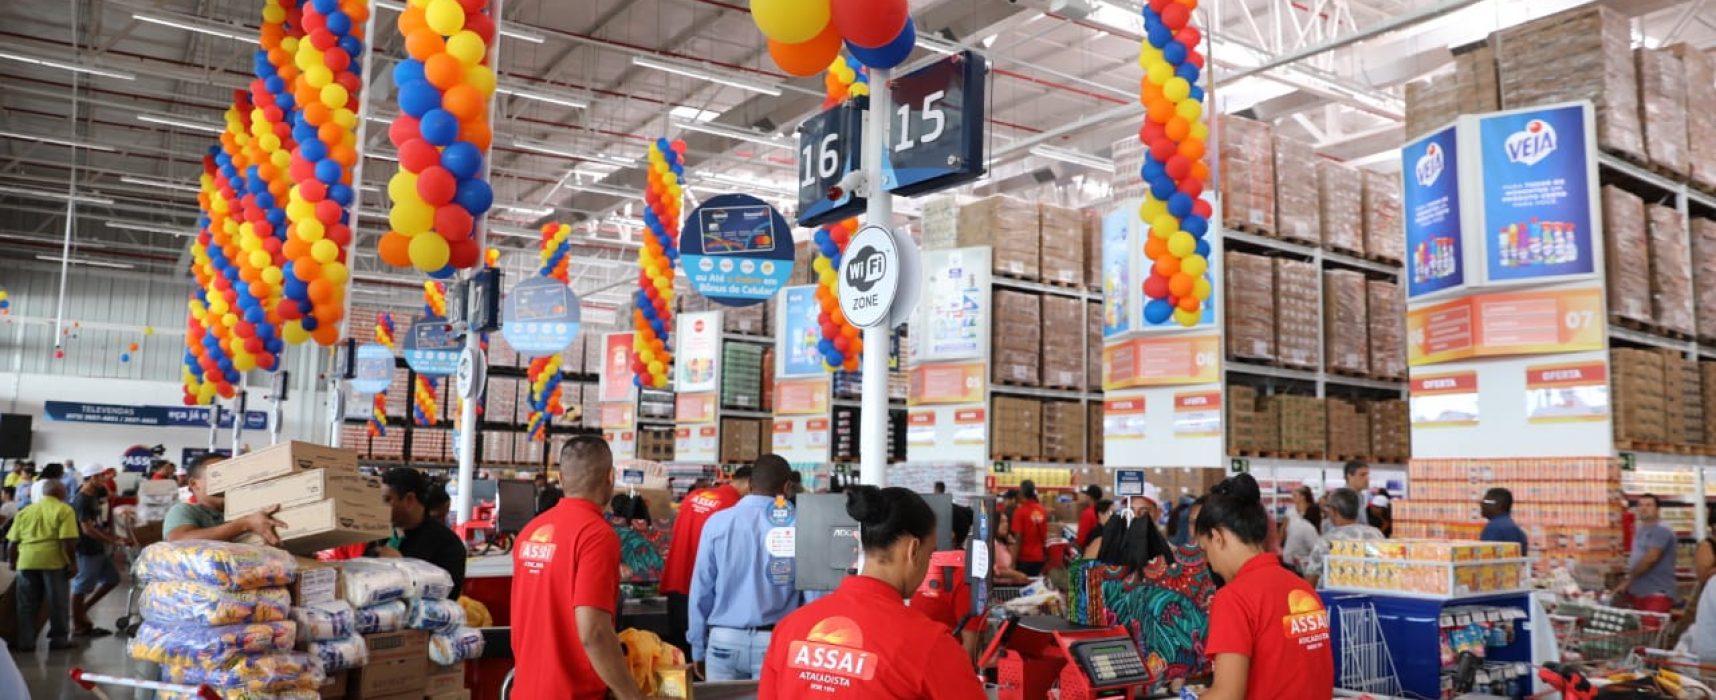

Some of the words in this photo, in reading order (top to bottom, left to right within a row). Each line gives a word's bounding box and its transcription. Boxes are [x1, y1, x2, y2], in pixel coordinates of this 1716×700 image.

[895, 90, 945, 152] 15
[1508, 132, 1553, 161] VEJA
[801, 133, 839, 187] 16
[853, 295, 879, 311] ZONE
[1565, 310, 1594, 329] 07
[1422, 378, 1457, 390] OFERTA
[1542, 369, 1582, 380] OFERTA
[794, 645, 868, 674] ASSAÍ
